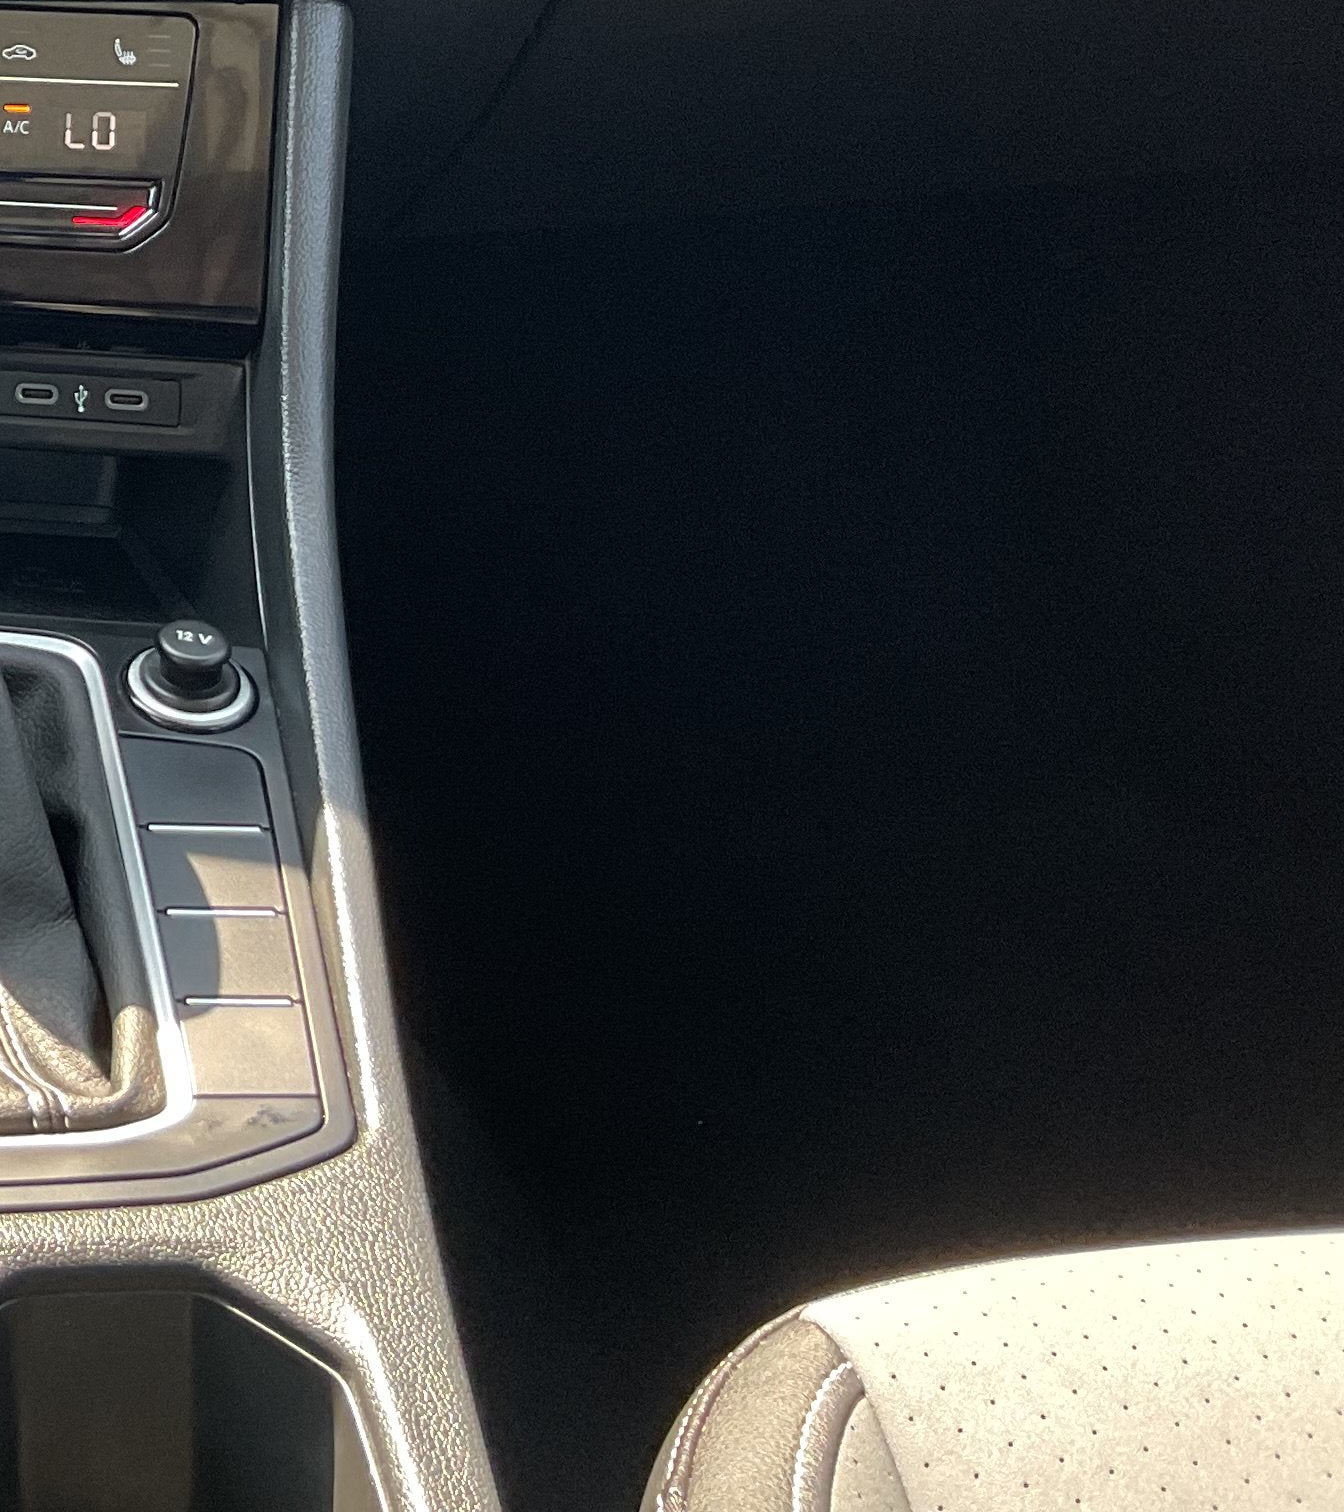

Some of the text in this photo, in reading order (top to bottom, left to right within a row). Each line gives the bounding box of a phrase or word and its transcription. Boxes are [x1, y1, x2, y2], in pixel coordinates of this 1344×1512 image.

[3, 120, 30, 135] A/C
[175, 629, 213, 645] 12 V
